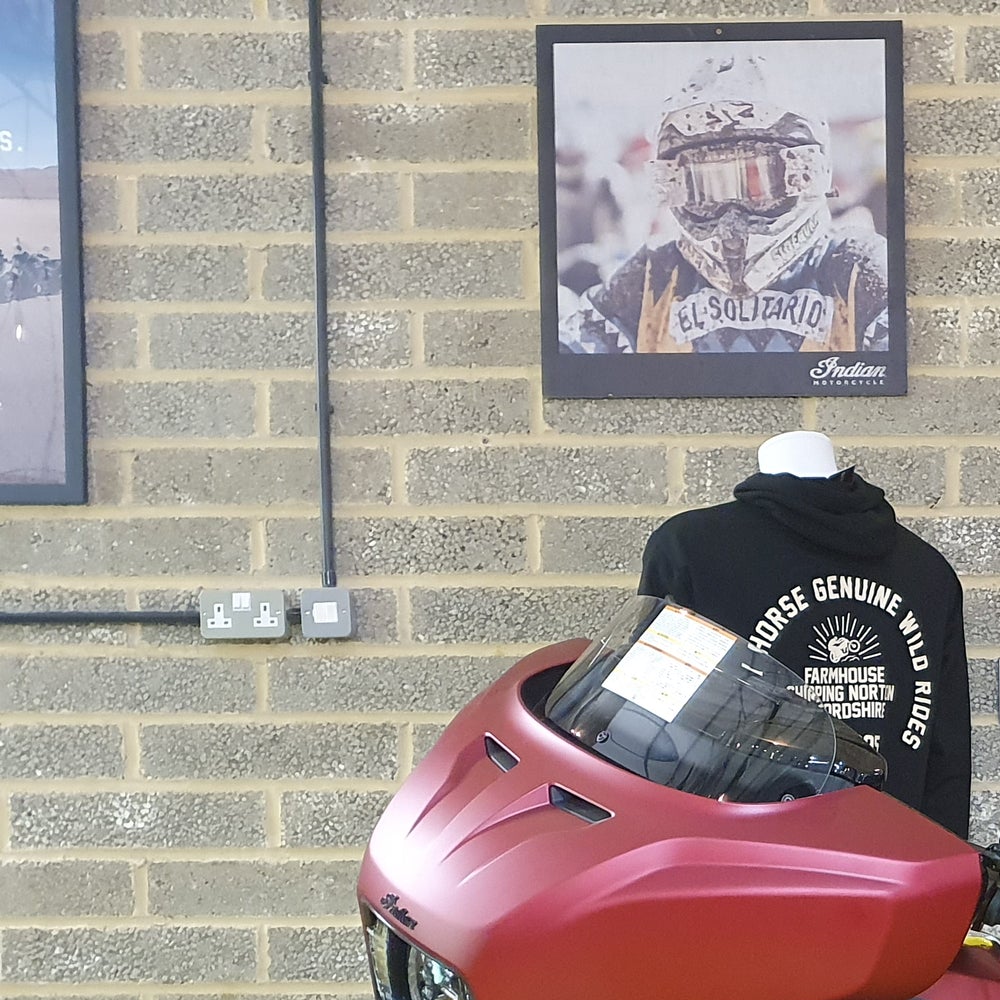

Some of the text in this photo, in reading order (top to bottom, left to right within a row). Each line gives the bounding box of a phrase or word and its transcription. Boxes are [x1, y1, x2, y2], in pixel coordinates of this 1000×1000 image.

[677, 295, 823, 333] EL SOLITARIO
[809, 356, 888, 379] Indian
[747, 575, 932, 750] HORSE GENUINE WILD RIDES
[804, 666, 885, 685] FARMHOUSE
